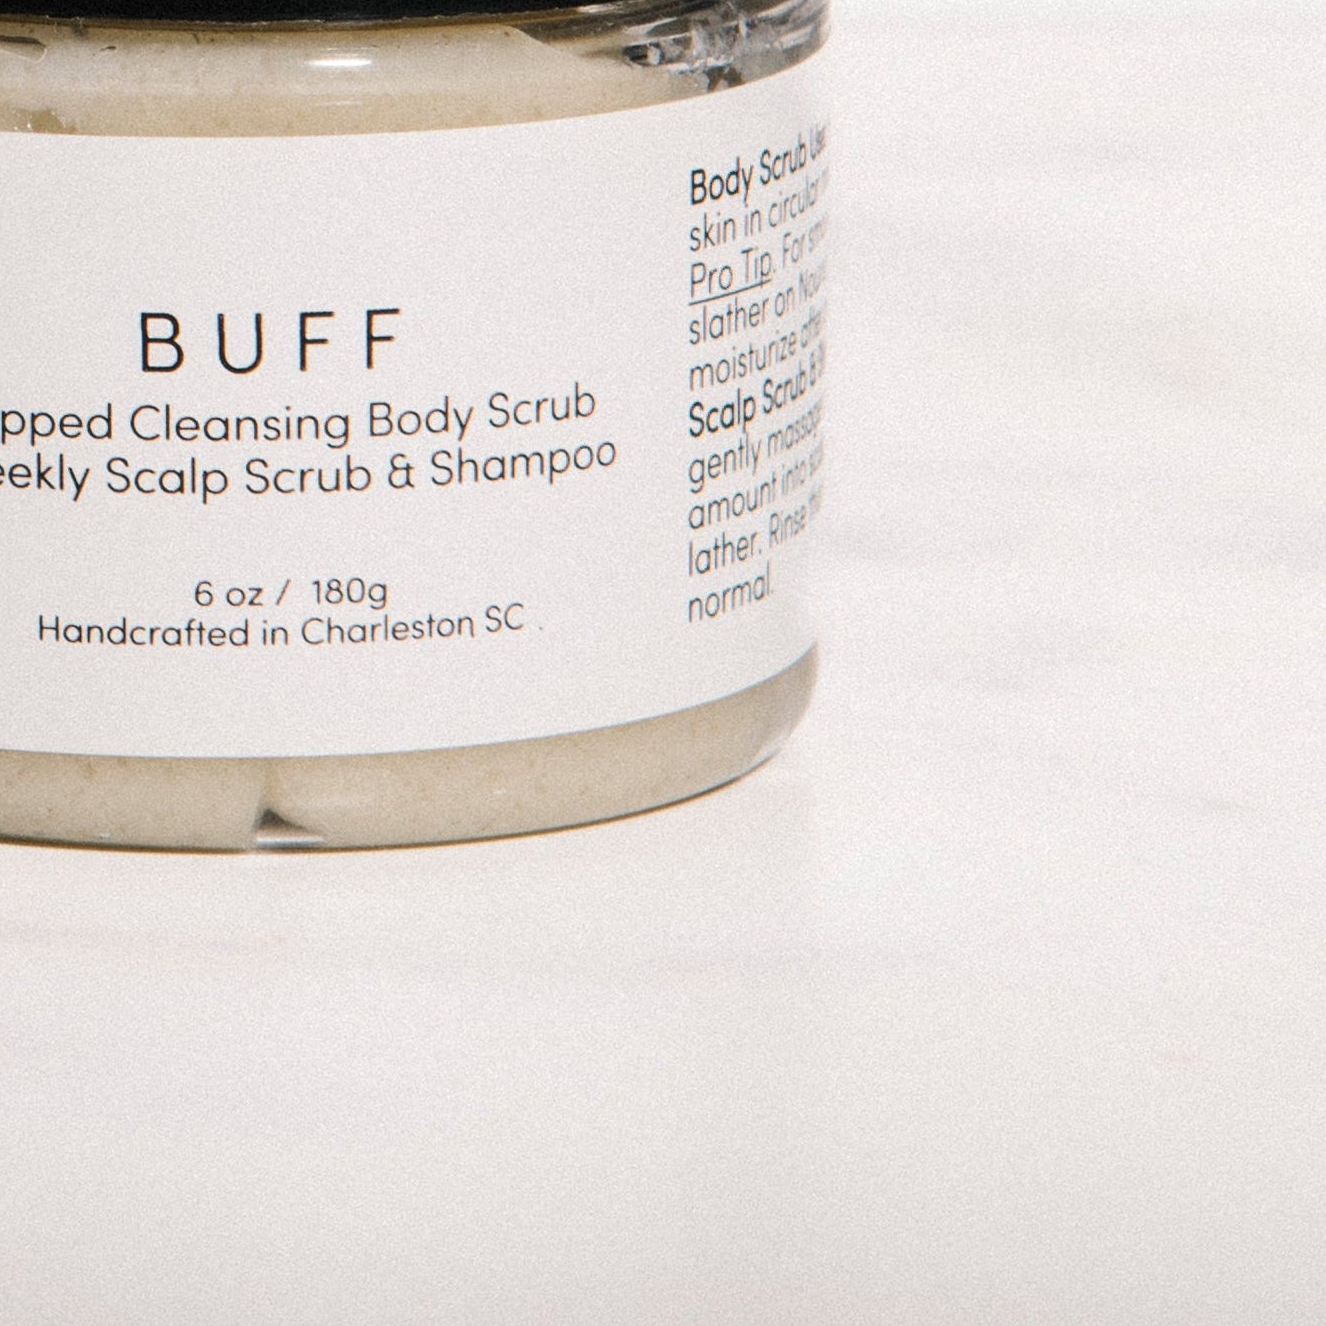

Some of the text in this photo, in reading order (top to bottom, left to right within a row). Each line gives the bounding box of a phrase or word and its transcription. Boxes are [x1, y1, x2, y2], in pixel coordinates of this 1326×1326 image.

[690, 155, 753, 205] Body
[759, 133, 807, 185] Scrub
[690, 212, 736, 252] skin
[744, 210, 761, 237] in
[690, 262, 734, 298] Pro
[740, 247, 776, 288] Tip.
[139, 307, 401, 375] BUFF
[689, 285, 795, 345] slather on
[690, 330, 797, 391] moisturize
[130, 403, 350, 448] Cleansing
[368, 394, 474, 442] Body
[488, 381, 596, 428] Scrub
[689, 387, 757, 437] Scalp
[763, 366, 807, 414] Scrub
[105, 456, 228, 504] Scalp
[245, 454, 372, 494] Scrub
[430, 441, 617, 485] Shampoo
[688, 432, 763, 494] gently
[688, 470, 777, 530] amount
[689, 531, 763, 576] lather.
[194, 580, 214, 607] 6
[225, 587, 263, 607] oz
[312, 577, 388, 610] 180g
[688, 559, 775, 622] normal.
[38, 603, 525, 646] Handcrafted in Charleston SC
